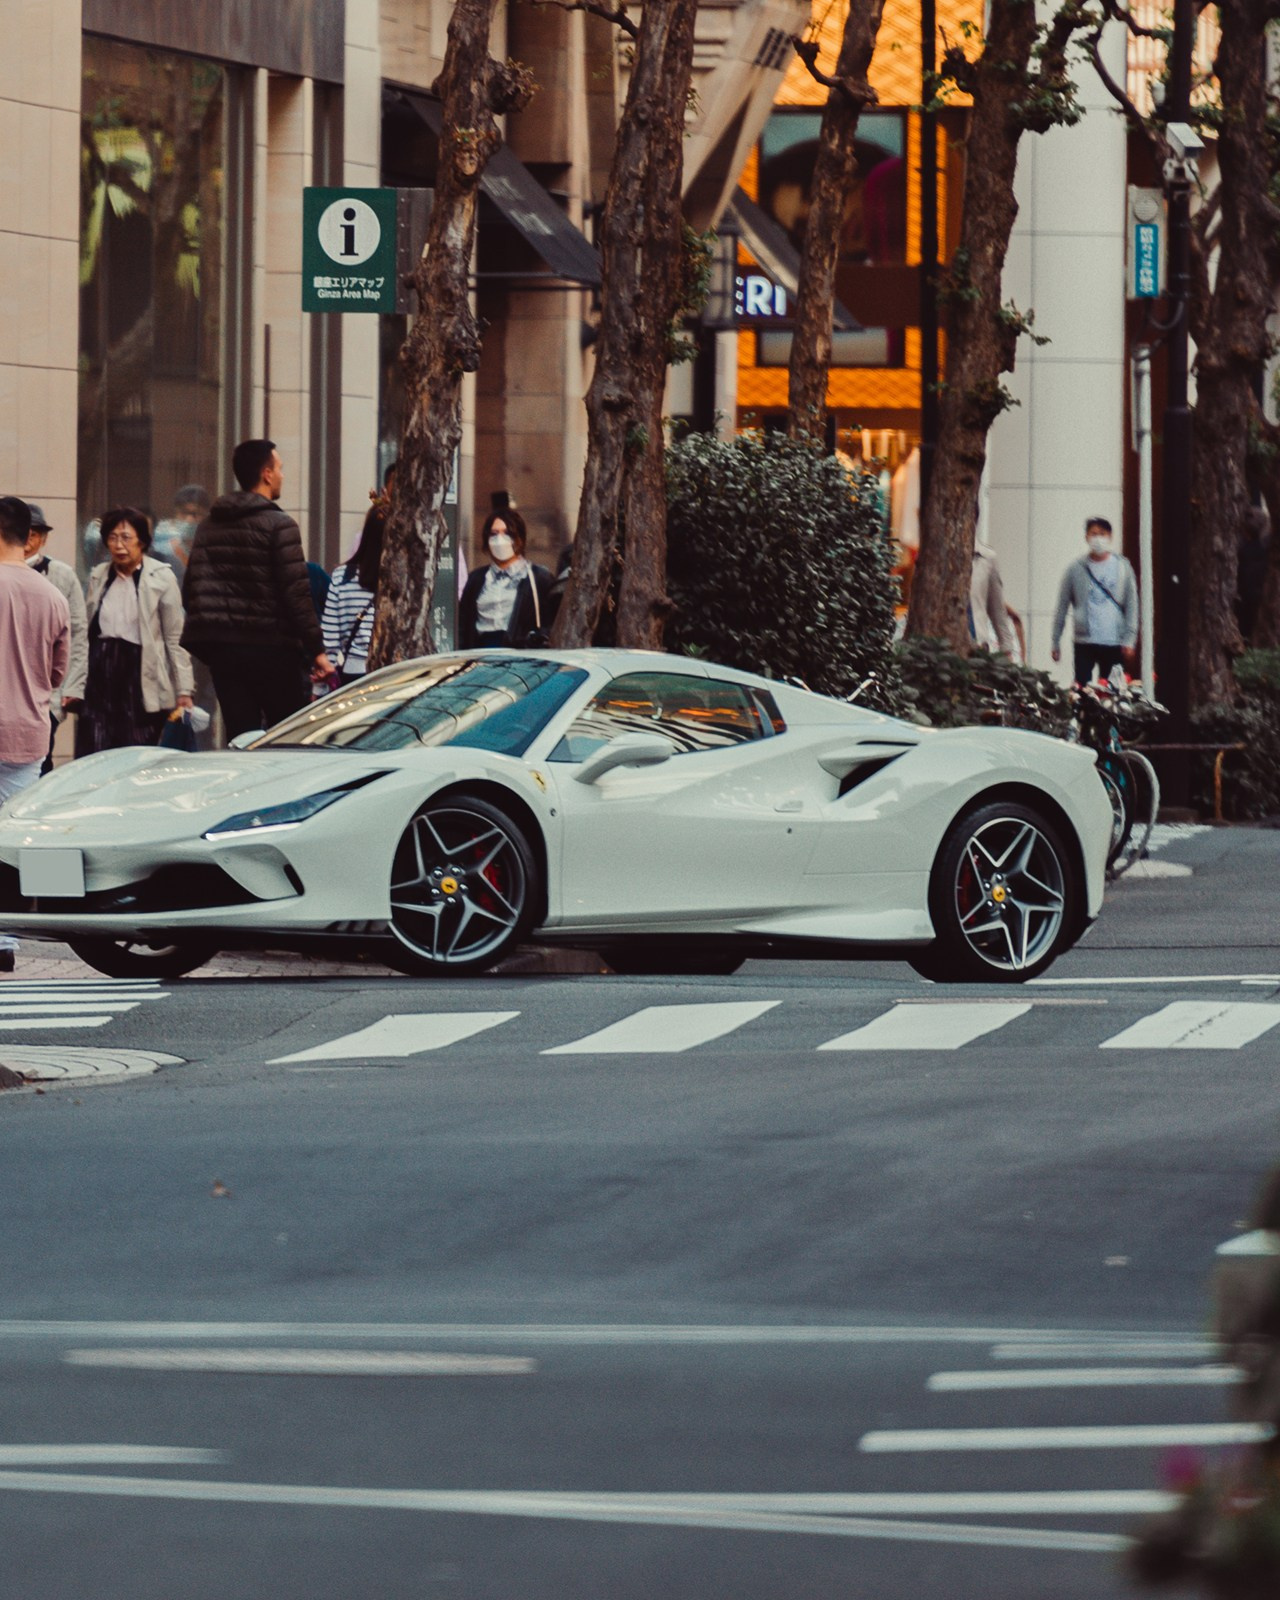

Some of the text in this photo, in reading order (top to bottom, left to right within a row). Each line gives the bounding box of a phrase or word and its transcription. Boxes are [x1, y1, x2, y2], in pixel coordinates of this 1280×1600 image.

[317, 289, 381, 301] Ginza Area Map
